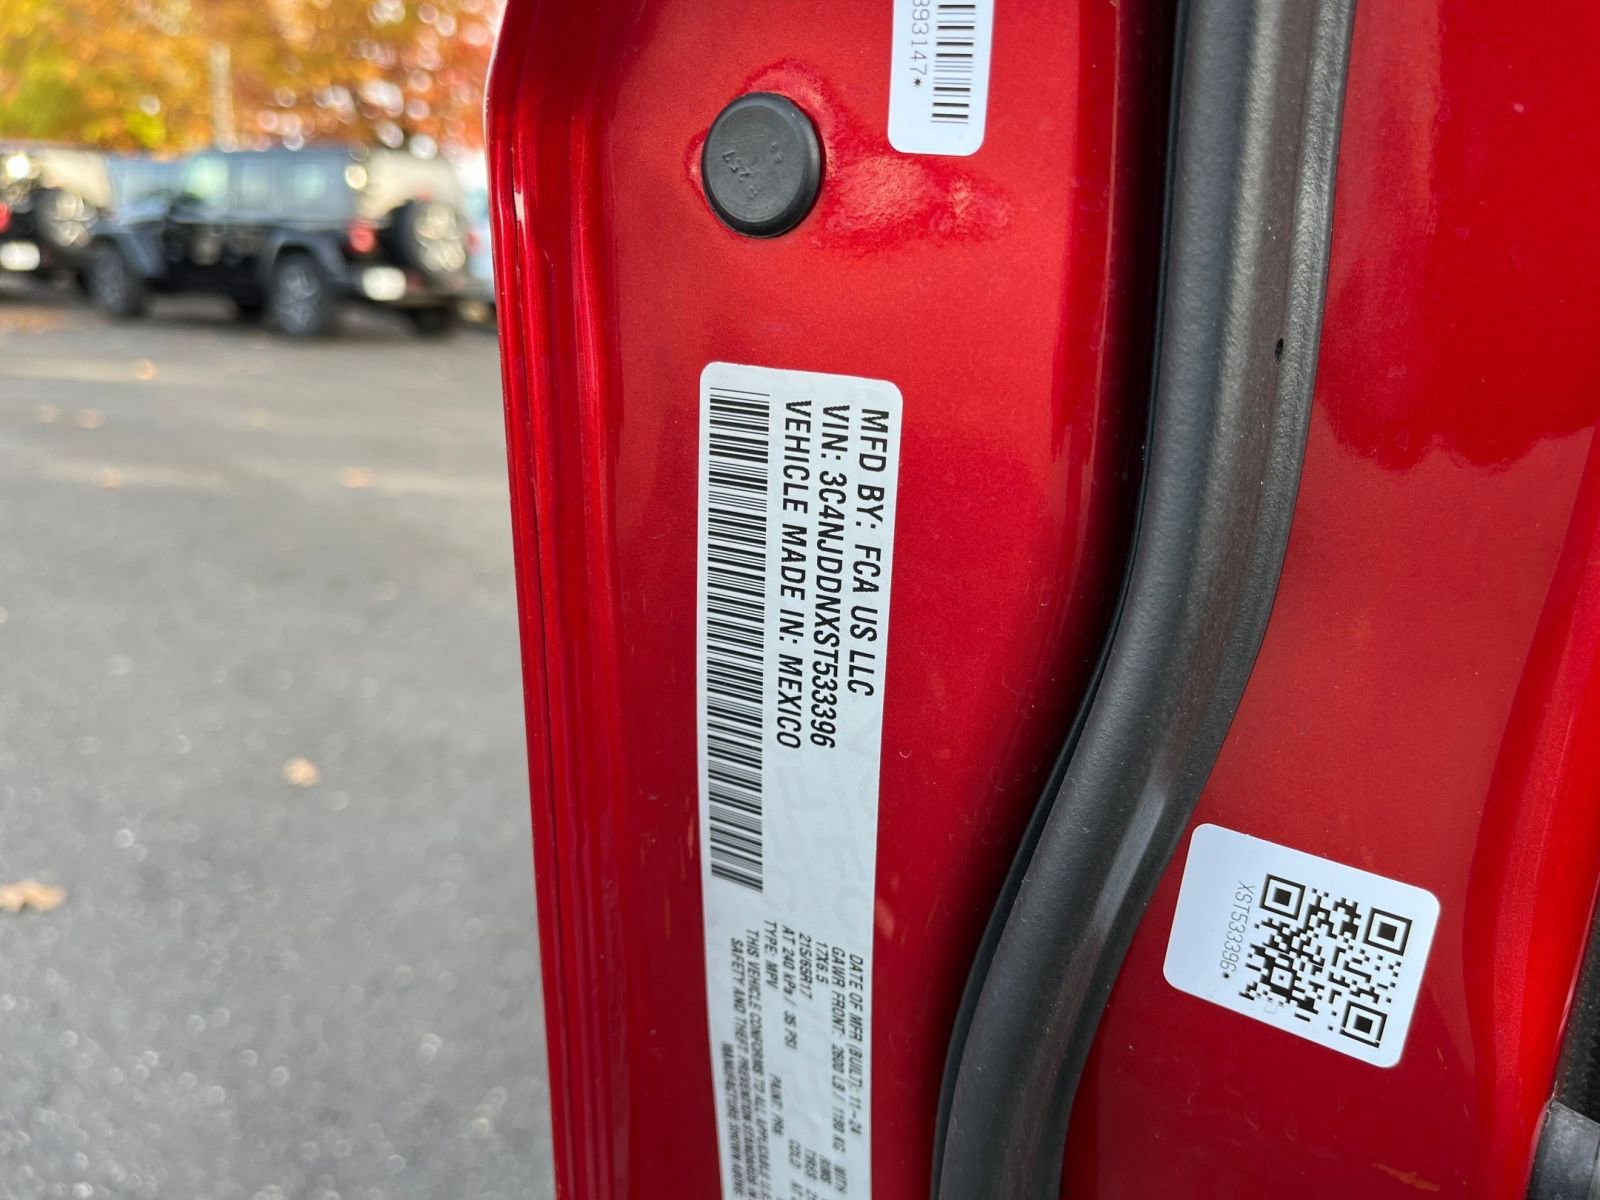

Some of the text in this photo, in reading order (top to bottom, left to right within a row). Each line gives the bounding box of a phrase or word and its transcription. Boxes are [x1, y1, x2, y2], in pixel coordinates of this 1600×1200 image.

[847, 409, 889, 696] MFD BY: FCA US LLC
[776, 400, 812, 749] VEHICLE MADE IN: MEXICO
[810, 405, 850, 749] VIN: 3C4NJDDNXST533396
[746, 929, 759, 958] THIS
[764, 920, 777, 956] TYPE:
[782, 925, 795, 944] AT
[731, 938, 744, 984] SAFETY
[766, 960, 778, 989] MPV
[782, 947, 795, 969] 240
[799, 933, 813, 1000] 215/65R17
[815, 941, 829, 984] 17X6.5
[832, 947, 845, 989] GAWR
[849, 954, 863, 990] DATE
[733, 987, 746, 1015] AND
[748, 961, 761, 1009] VEHICLE
[849, 992, 863, 1012] OF
[832, 991, 845, 1038] FRONT:
[849, 1013, 863, 1042] MFR
[845, 1043, 863, 1093] (BUILT):
